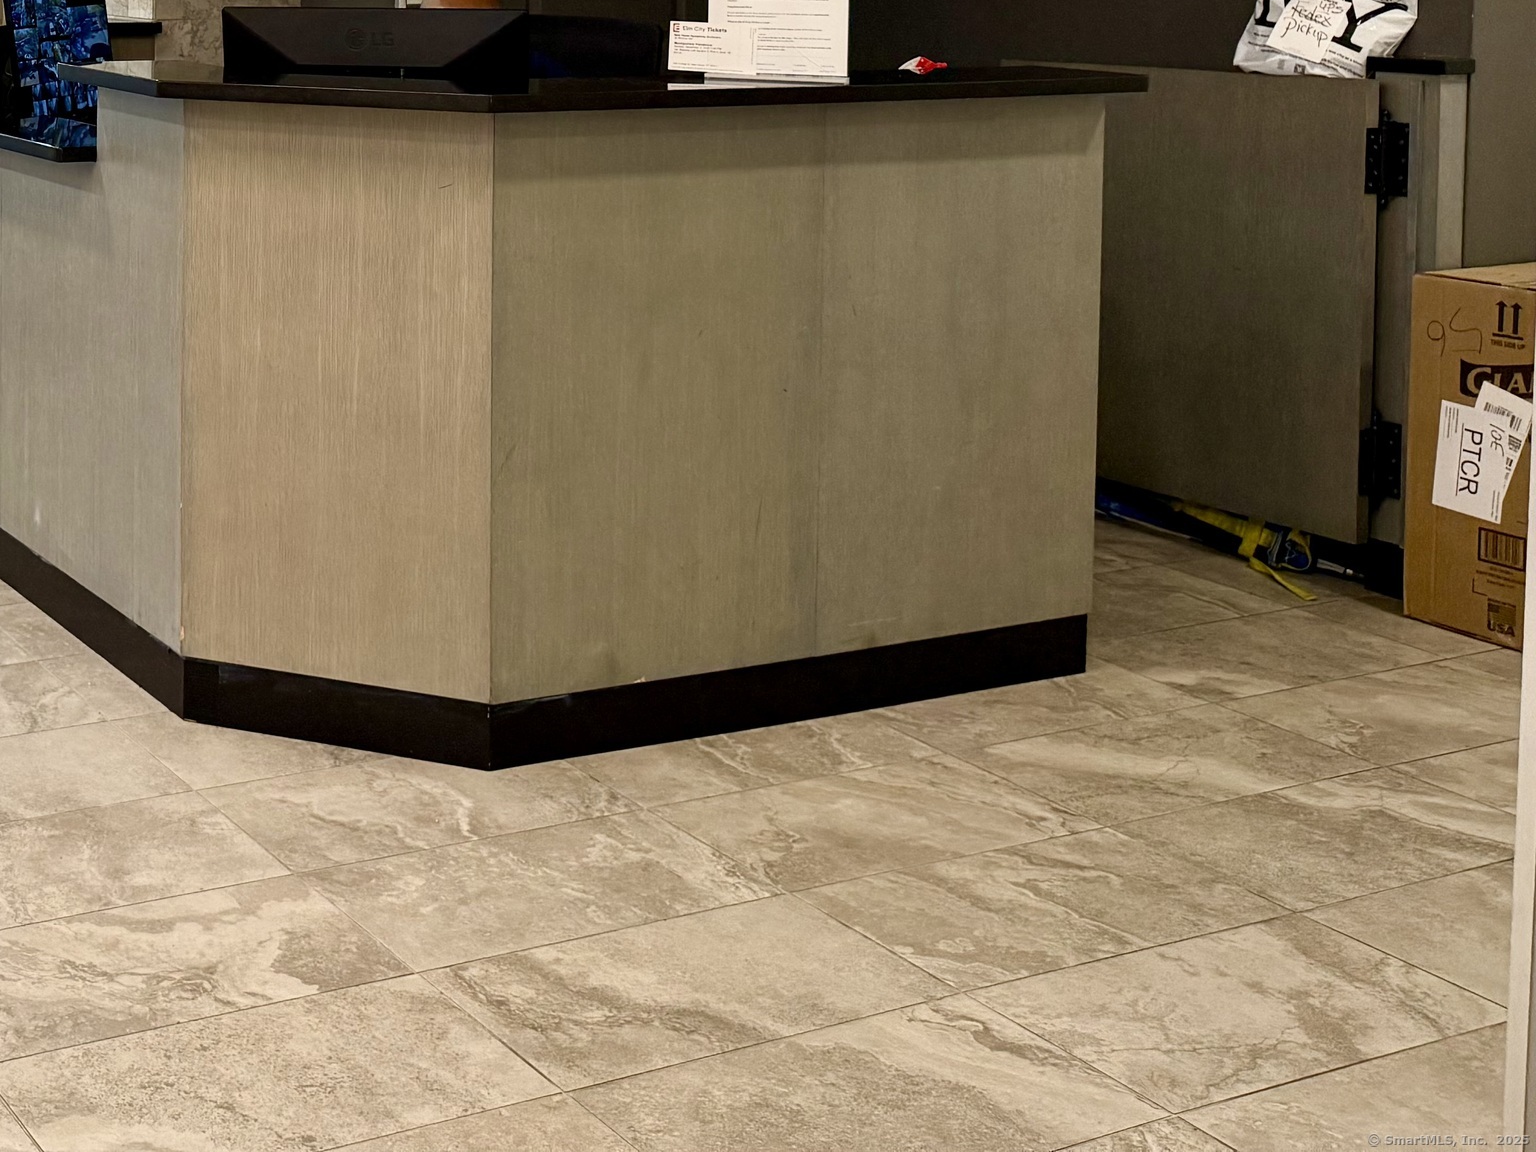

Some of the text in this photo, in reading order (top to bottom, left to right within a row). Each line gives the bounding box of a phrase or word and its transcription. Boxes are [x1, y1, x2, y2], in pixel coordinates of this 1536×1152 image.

[370, 31, 395, 46] LG
[1504, 341, 1516, 349] SIDE
[1459, 427, 1483, 495] PTCR
[1487, 620, 1515, 637] USA
